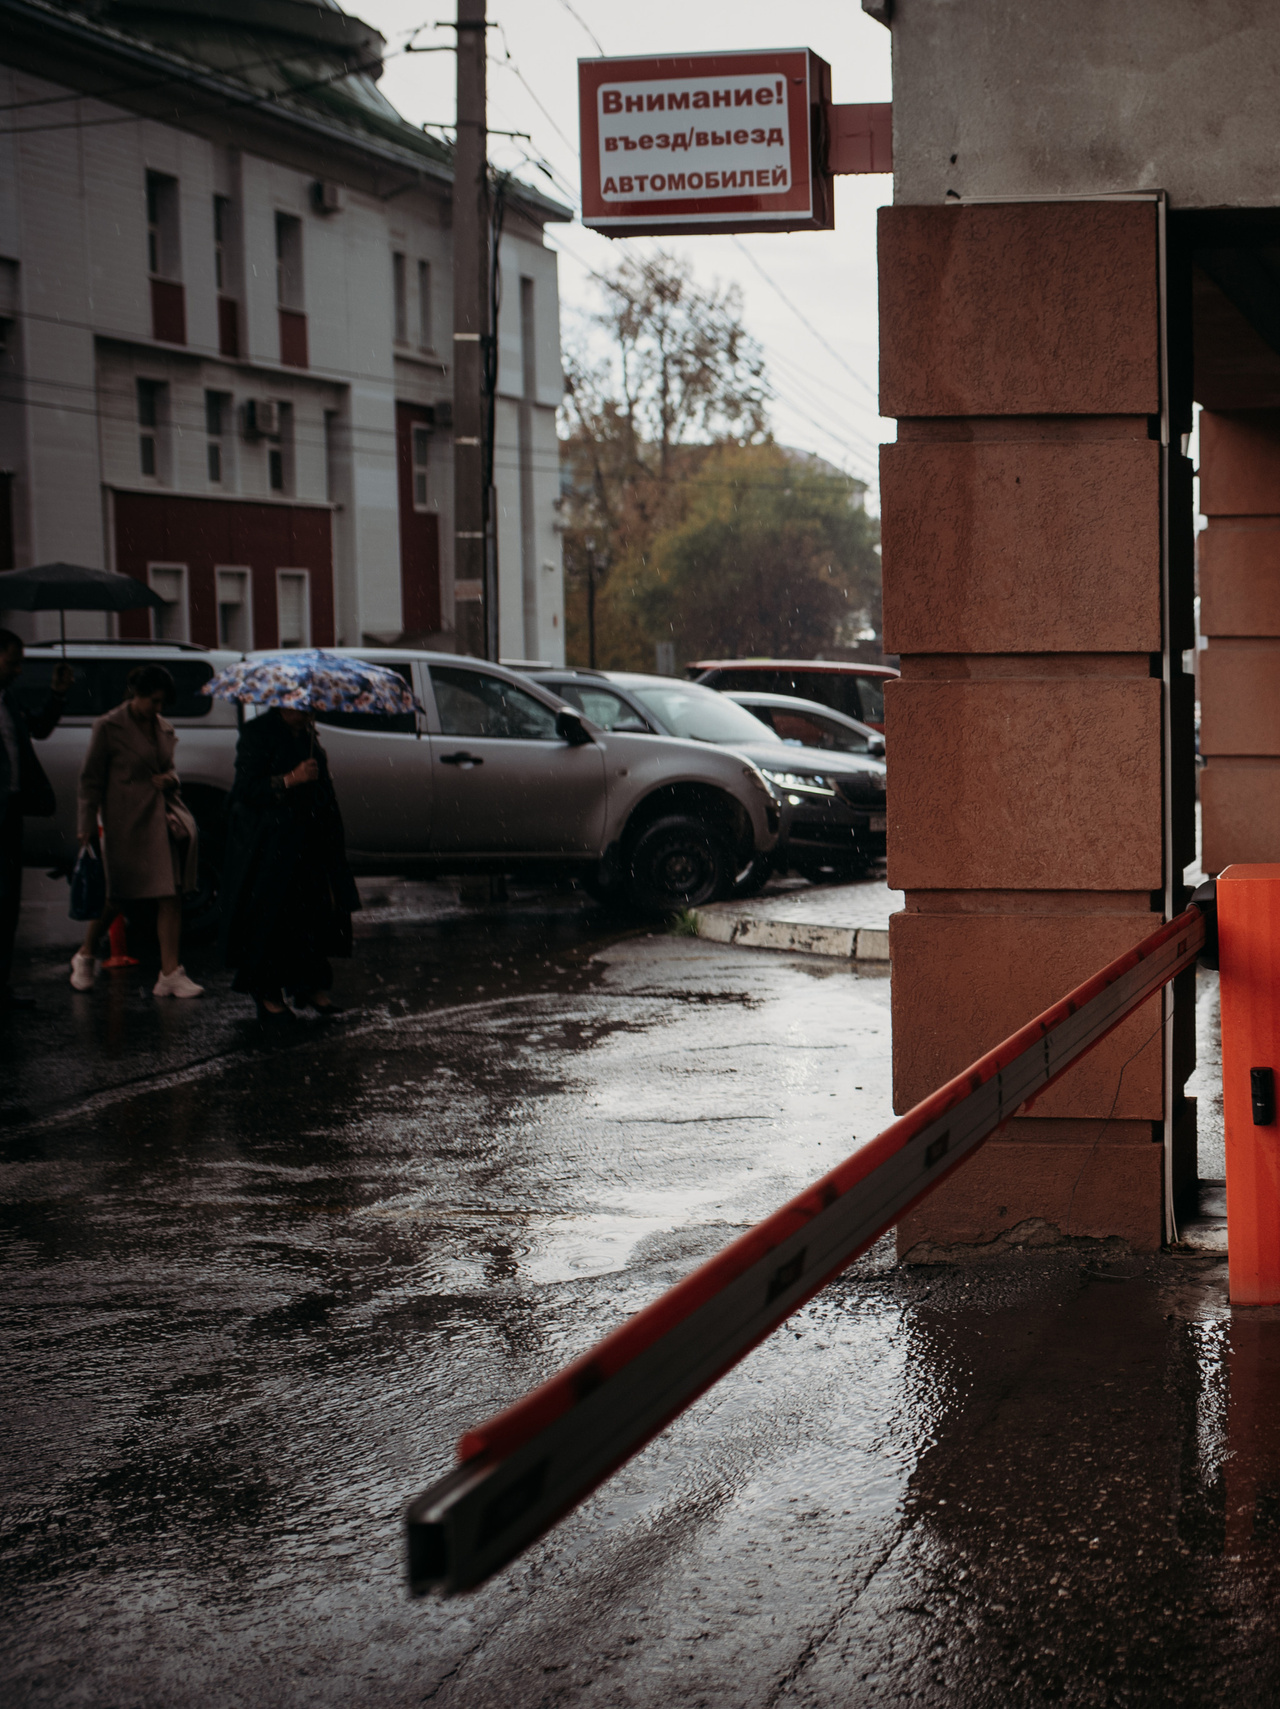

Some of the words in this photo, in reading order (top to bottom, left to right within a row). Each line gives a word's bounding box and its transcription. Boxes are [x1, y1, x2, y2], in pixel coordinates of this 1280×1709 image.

[602, 81, 784, 114] Внимание!
[604, 127, 784, 152] въезд/выезд
[602, 164, 788, 194] АВТОМОБИЛЕЙ
